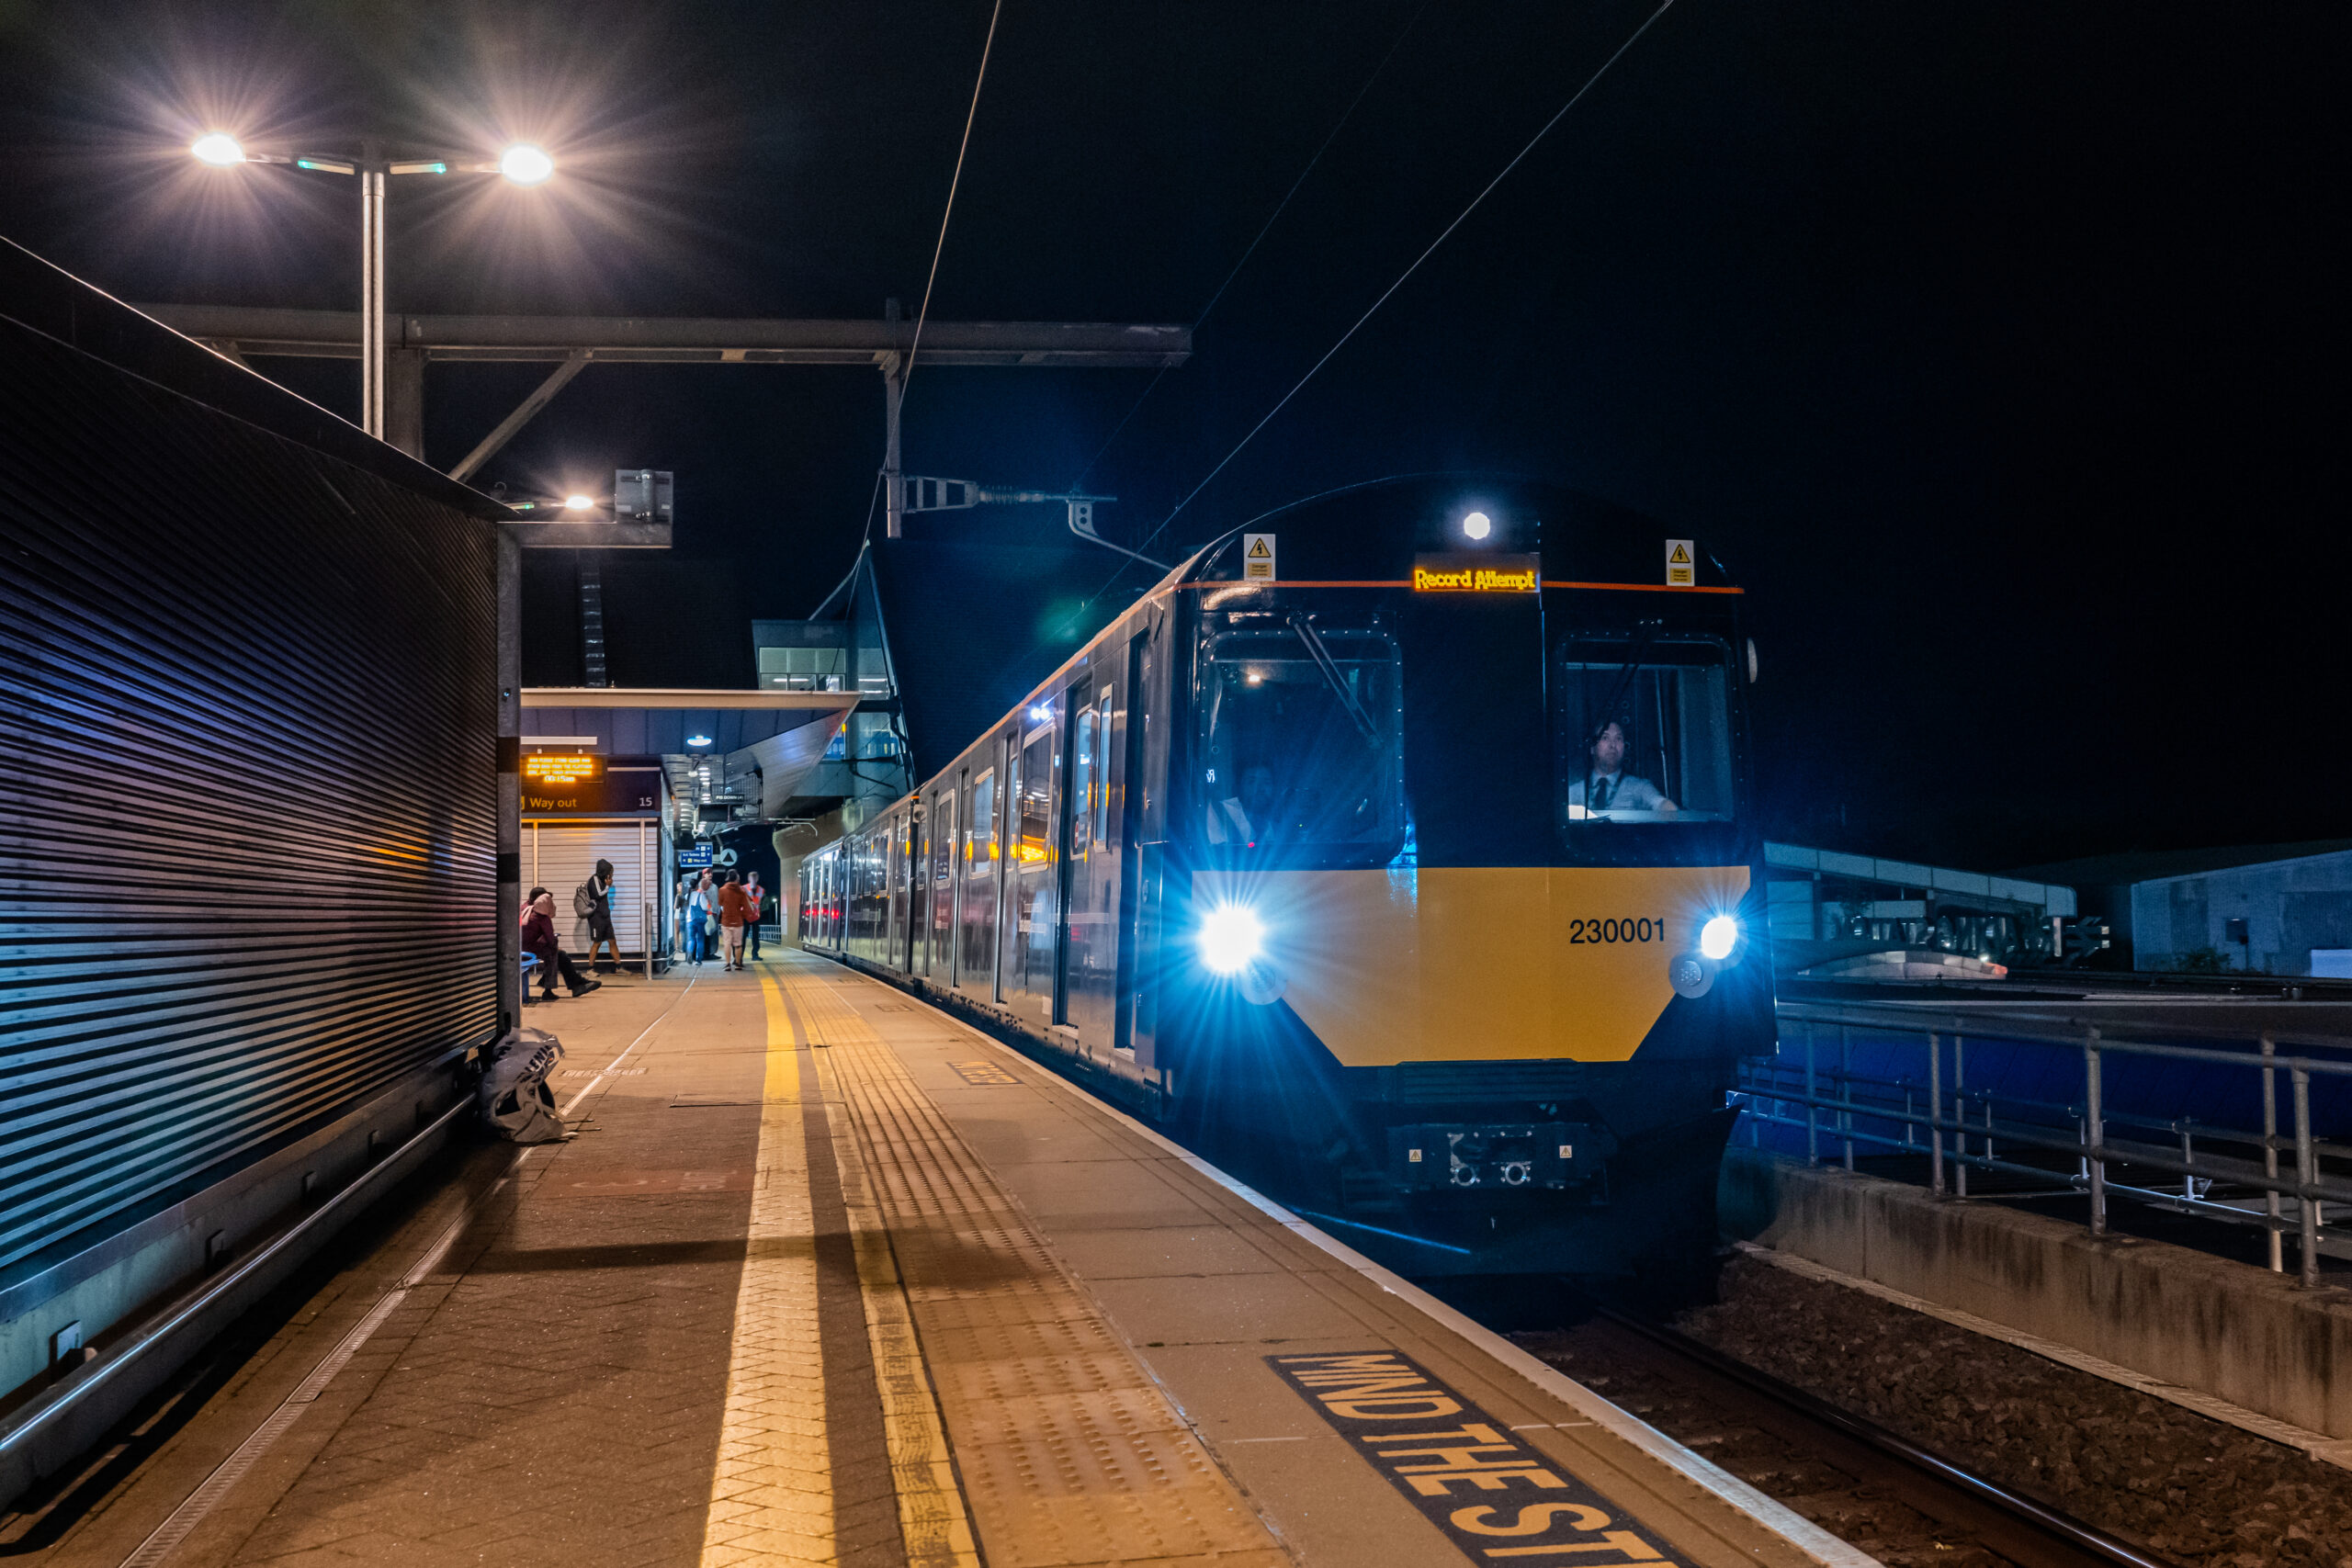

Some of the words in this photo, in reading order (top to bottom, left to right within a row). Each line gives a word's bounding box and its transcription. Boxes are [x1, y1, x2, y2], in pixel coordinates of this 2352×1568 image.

[1415, 570, 1472, 589] Record
[1475, 570, 1535, 590] Attempt
[529, 797, 554, 810] Way
[557, 798, 578, 808] out
[639, 796, 653, 807] 15
[1569, 918, 1664, 943] 230001
[1278, 1354, 1464, 1420] MIND
[1361, 1423, 1569, 1497] THE
[1449, 1502, 1679, 1568] ST
